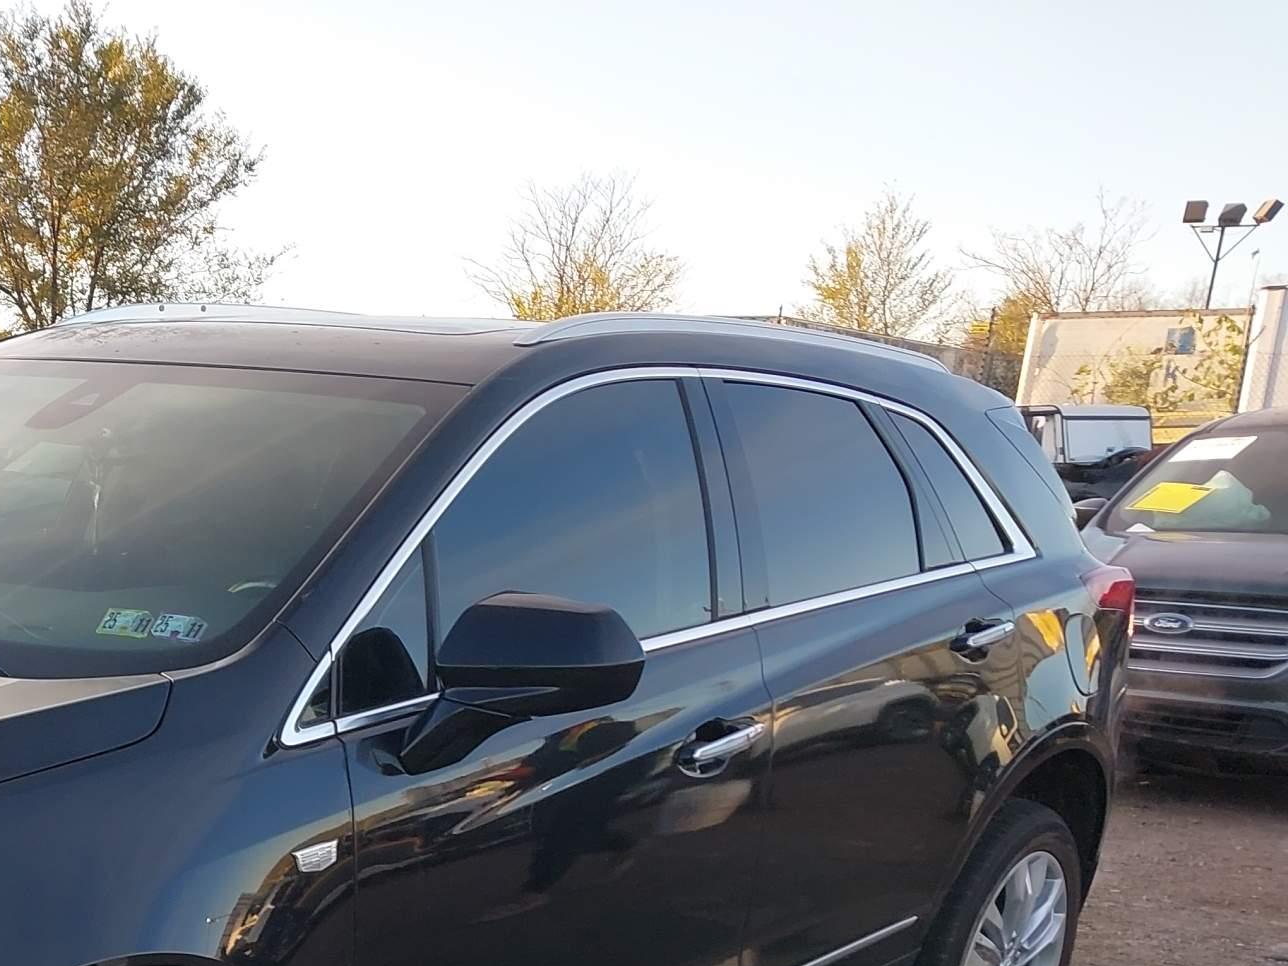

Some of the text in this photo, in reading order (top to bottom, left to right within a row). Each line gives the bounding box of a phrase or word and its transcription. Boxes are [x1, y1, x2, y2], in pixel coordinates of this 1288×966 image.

[103, 611, 152, 633] 25 11
[154, 615, 205, 639] 25 11
